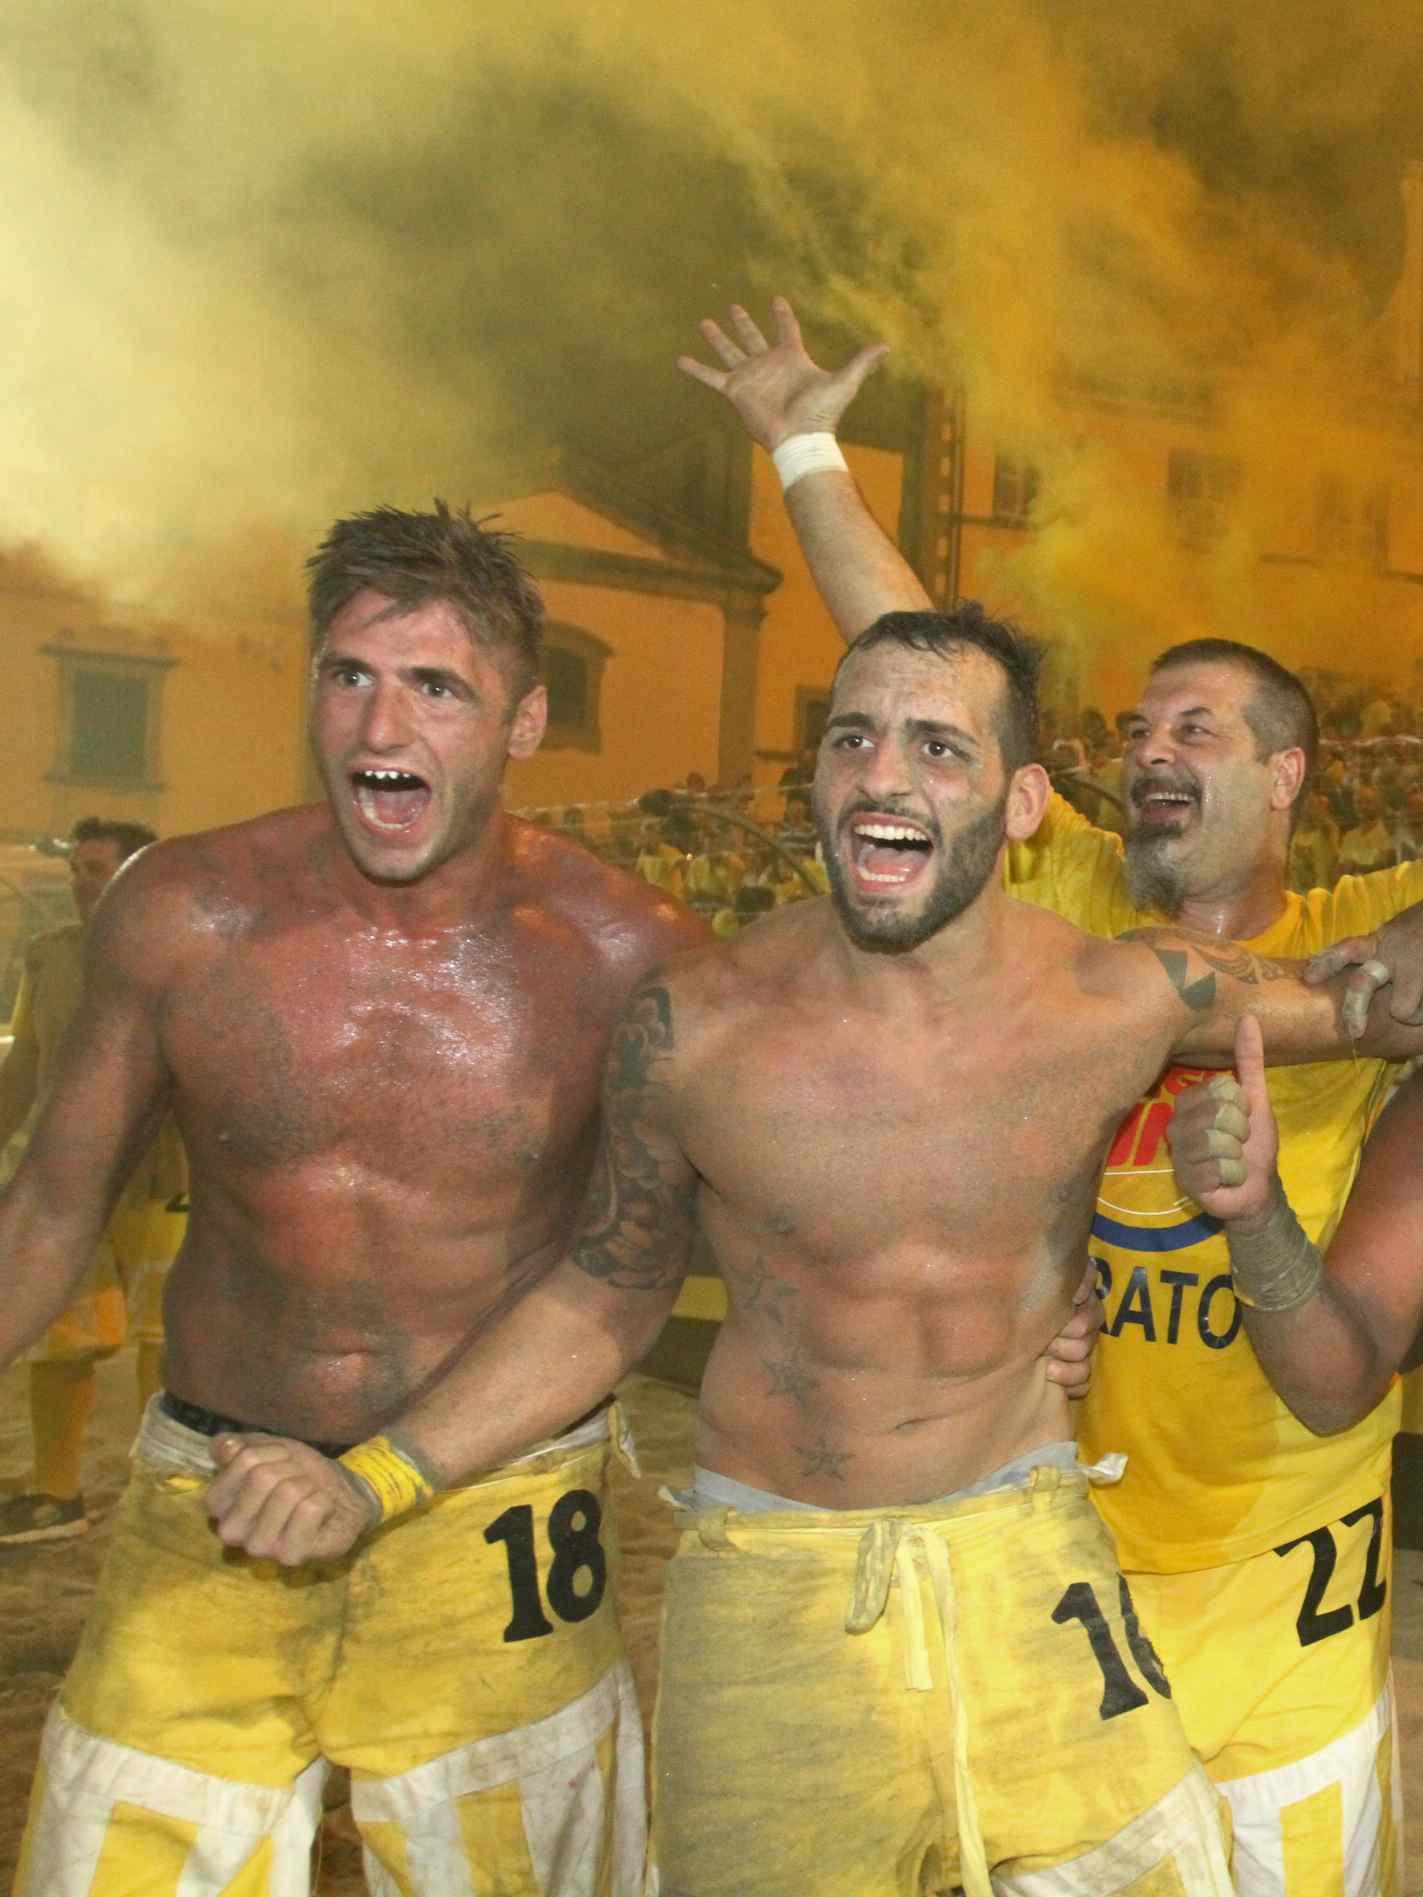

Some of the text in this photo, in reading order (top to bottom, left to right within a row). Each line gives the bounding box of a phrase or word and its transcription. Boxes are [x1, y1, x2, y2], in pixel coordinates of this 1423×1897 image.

[1094, 1256, 1242, 1350] RATO
[483, 1489, 607, 1643] 18
[1272, 1498, 1387, 1647] 22
